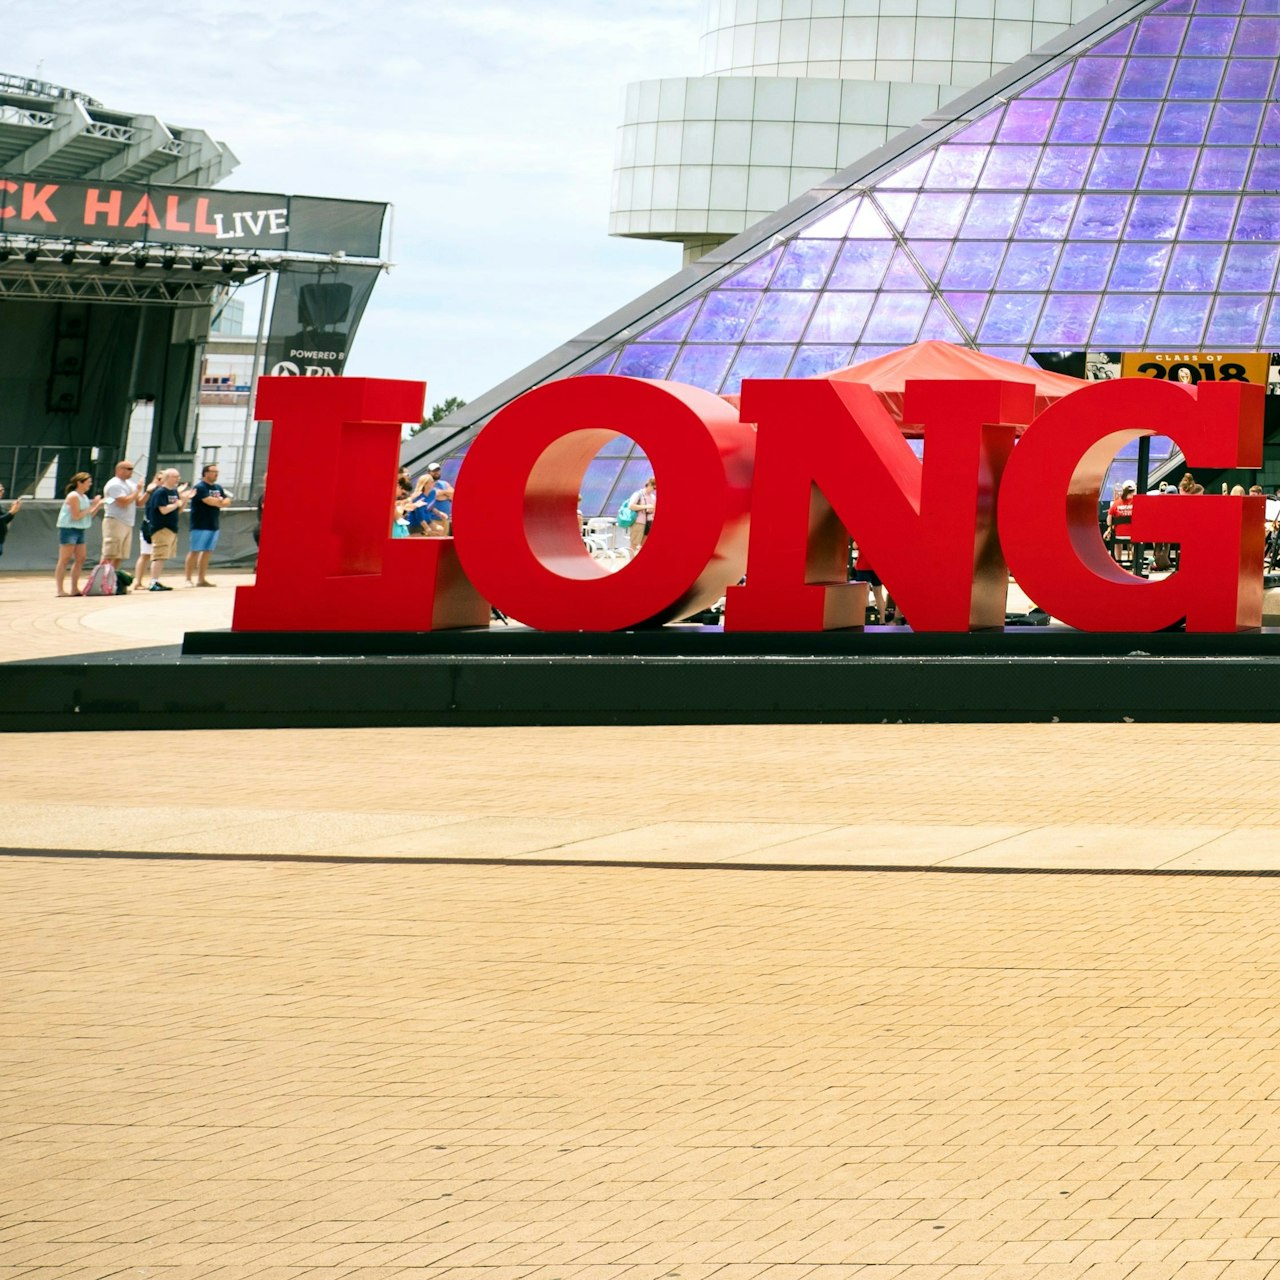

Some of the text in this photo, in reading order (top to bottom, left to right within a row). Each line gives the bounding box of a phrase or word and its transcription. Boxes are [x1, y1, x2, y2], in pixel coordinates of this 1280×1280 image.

[84, 187, 218, 234] HALL
[214, 208, 289, 239] LIVE
[290, 349, 337, 360] POWERED
[1155, 354, 1224, 362] CLASS OF
[1137, 362, 1250, 384] 2018
[233, 375, 1265, 633] LONG
